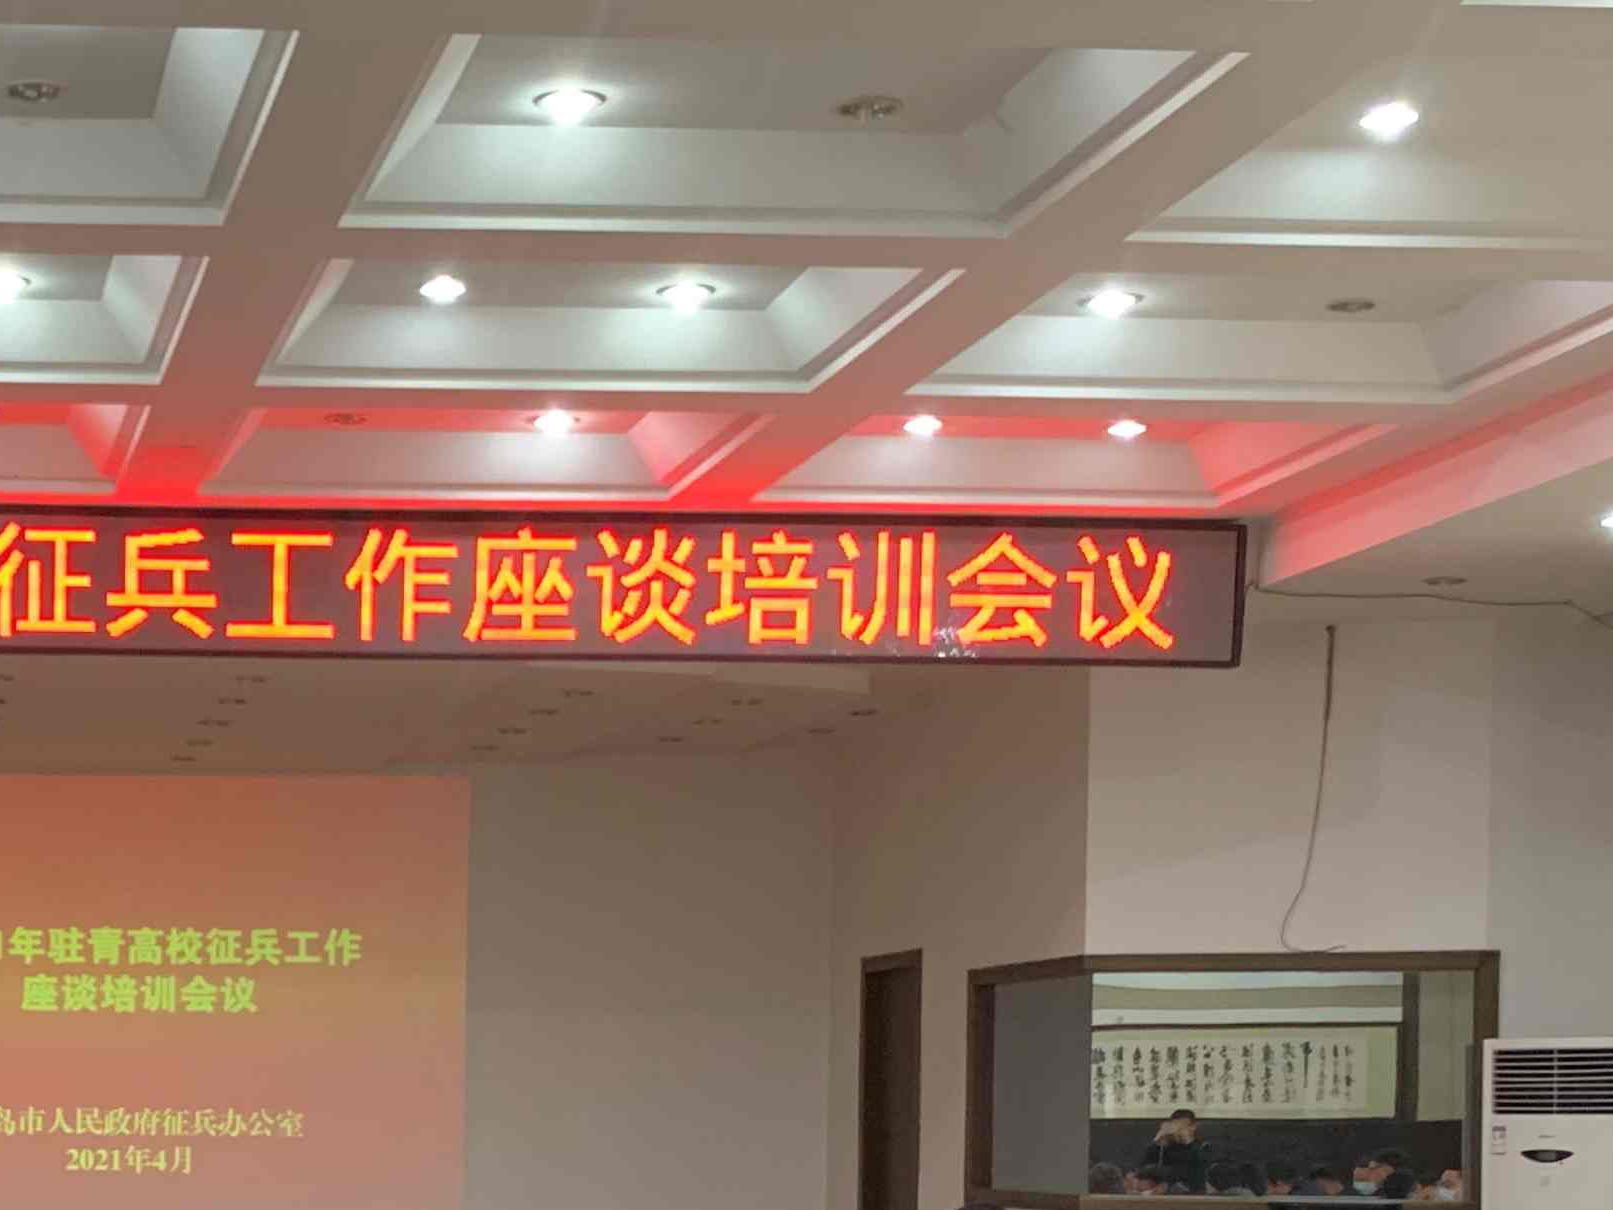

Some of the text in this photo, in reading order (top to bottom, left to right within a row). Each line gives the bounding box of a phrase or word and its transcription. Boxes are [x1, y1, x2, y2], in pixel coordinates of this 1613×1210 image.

[20, 974, 259, 1014] 座谈培训会议
[65, 1145, 193, 1175] 2021年4月
